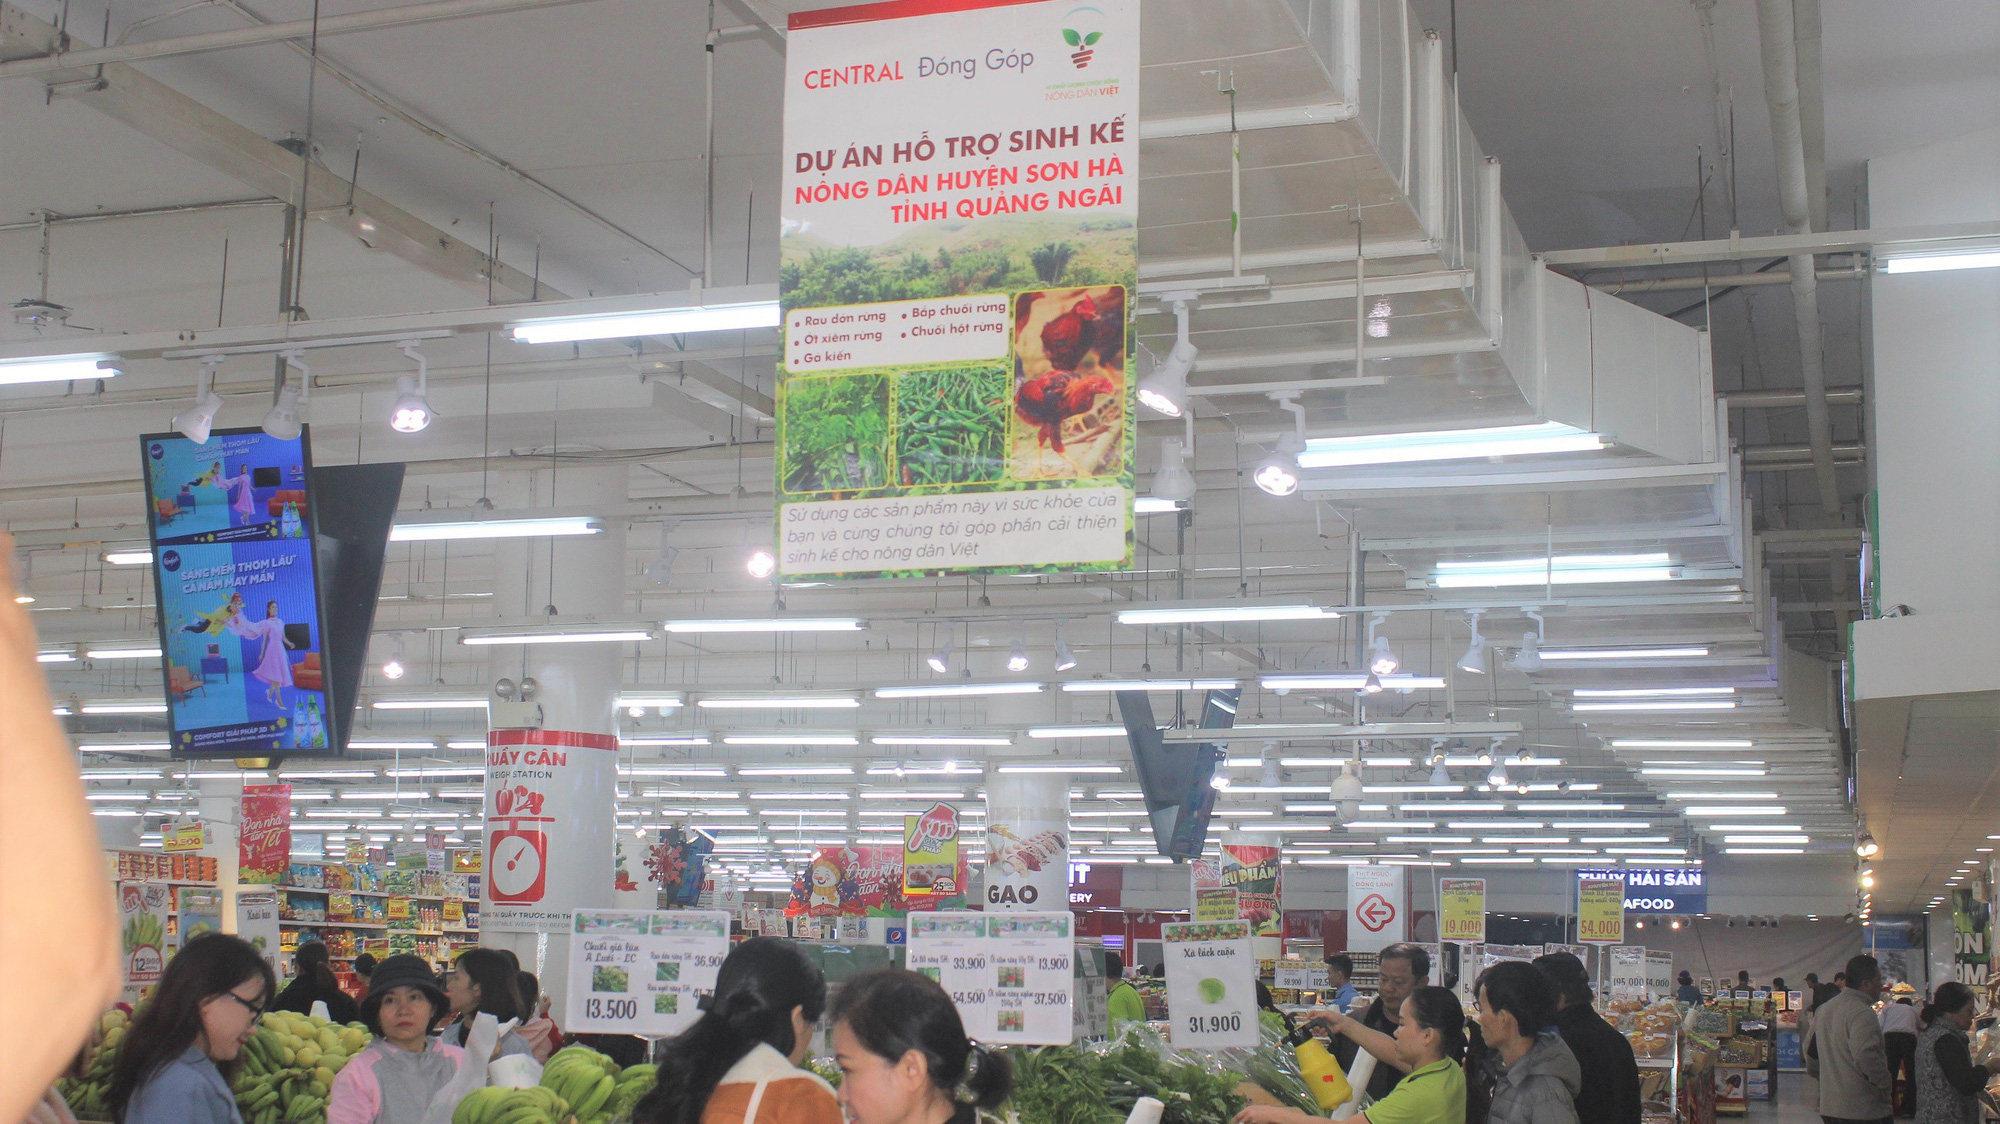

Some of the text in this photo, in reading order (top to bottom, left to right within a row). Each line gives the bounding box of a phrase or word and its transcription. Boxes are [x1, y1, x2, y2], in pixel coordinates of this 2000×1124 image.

[804, 48, 1034, 90] CENTRAL Đóng Góp
[1099, 85, 1119, 97] VIỆT
[796, 113, 1126, 176] DỰ ÁN HỖ TRỢ SINH KẾ
[795, 151, 1125, 205] NÔNG DÂN HUYỆN SƠN HÀ
[891, 183, 1122, 224] TỈNH QUẢNG NGÃI
[940, 303, 972, 316] chuối
[805, 316, 827, 326] Rau
[822, 332, 850, 343] xiêm
[911, 324, 946, 337] Chuối
[787, 508, 807, 522] Sử
[810, 507, 849, 523] dụng
[853, 505, 879, 518] các
[883, 502, 909, 517] sản
[962, 501, 990, 515] này
[1012, 497, 1039, 511] sức
[1044, 493, 1083, 509] khỏe
[1088, 492, 1117, 507] của
[787, 529, 815, 543] bạn
[886, 523, 933, 539] chúng
[939, 521, 958, 536] tôi
[964, 521, 996, 537] góp
[1047, 516, 1071, 530] cải
[1077, 515, 1117, 530] thiện
[787, 543, 979, 564] sinh kế cho nông dân Việt
[224, 576, 249, 588] MAY
[524, 748, 566, 766] CÂN
[513, 771, 552, 779] STATION
[1629, 870, 1660, 886] HẢI
[1664, 870, 1702, 886] SẢN
[934, 882, 944, 891] 25
[988, 885, 1038, 908] GẠO
[1446, 919, 1482, 933] 19.000
[1581, 920, 1620, 934] 54.000
[135, 958, 145, 971] 12
[586, 998, 637, 1019] 13.500
